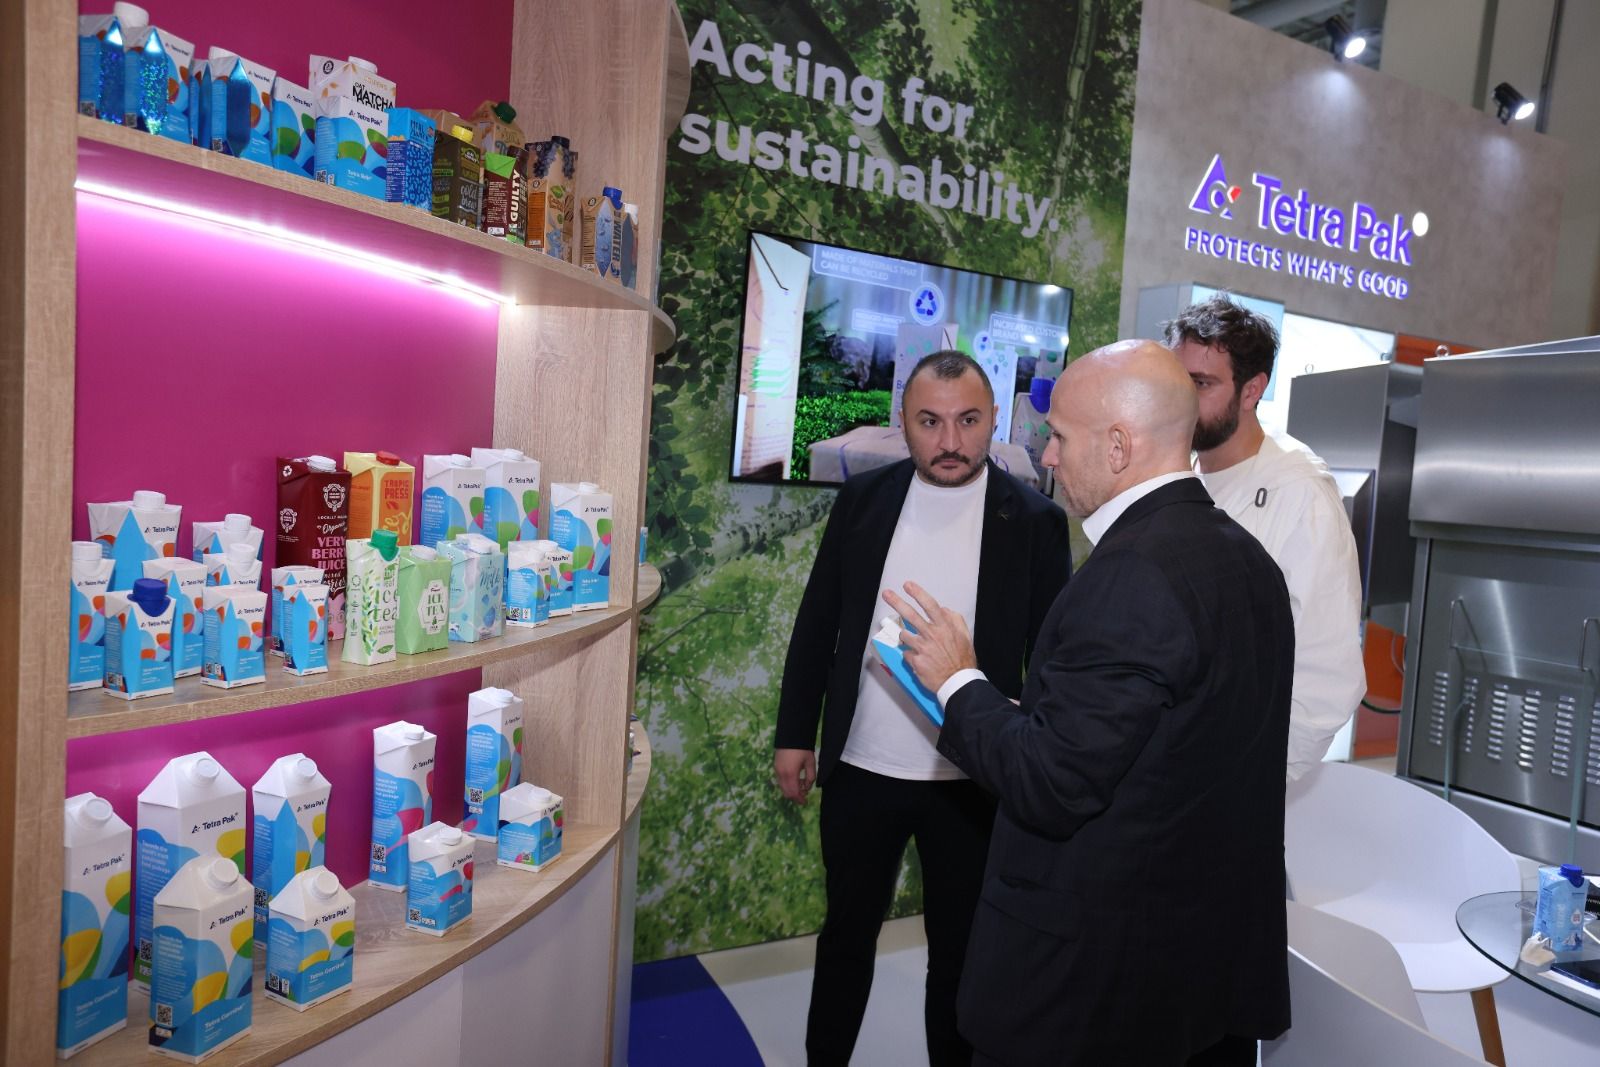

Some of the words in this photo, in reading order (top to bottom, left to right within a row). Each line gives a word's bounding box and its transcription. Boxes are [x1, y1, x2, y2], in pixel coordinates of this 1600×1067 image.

[689, 19, 884, 126] Acting
[901, 77, 975, 139] for
[353, 85, 394, 109] MATCHA
[357, 111, 370, 122] Tetra
[371, 117, 382, 126] Pak
[678, 113, 1060, 239] sustainability.
[510, 169, 521, 222] GUILTY
[1252, 171, 1344, 248] Tetra
[1350, 201, 1413, 266] Pak
[612, 221, 622, 262] WATER
[1185, 227, 1283, 272] PROTECTS
[1287, 251, 1354, 289] WHAT'S
[1358, 269, 1408, 300] GOOD
[384, 480, 409, 488] TROPIC
[384, 487, 409, 499] PRESS
[152, 525, 165, 533] Tetra
[317, 536, 346, 548] VERY
[317, 559, 346, 570] JUICE
[428, 594, 444, 605] ICE
[426, 604, 445, 617] TEA
[303, 803, 315, 811] Tetra
[315, 799, 325, 808] Pak
[202, 818, 221, 831] Tetra
[222, 814, 237, 827] Pak
[92, 861, 110, 872] Tetra
[110, 854, 123, 866] Pak
[218, 914, 234, 926] Tetra
[234, 907, 246, 919] Pak
[321, 913, 337, 923] Tetra
[336, 909, 347, 918] Pak
